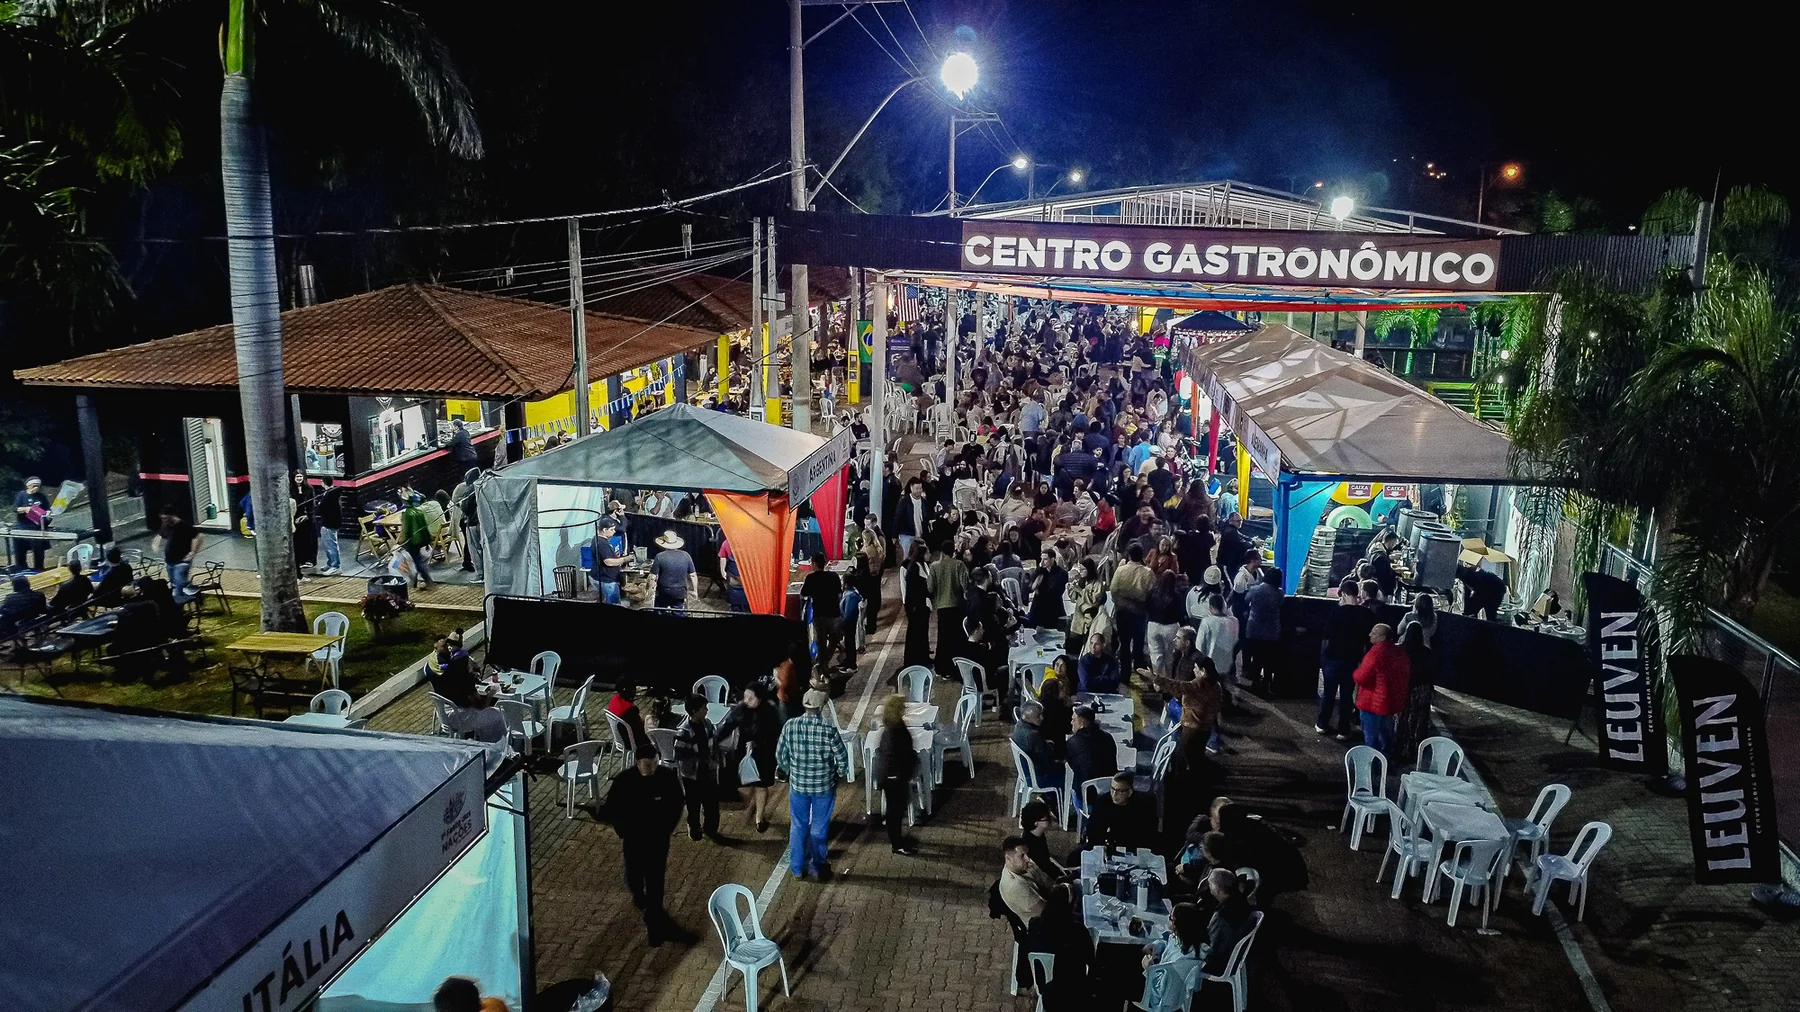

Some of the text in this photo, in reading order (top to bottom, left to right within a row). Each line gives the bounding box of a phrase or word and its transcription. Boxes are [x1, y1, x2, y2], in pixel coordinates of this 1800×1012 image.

[964, 235, 1495, 285] CENTRO GASTRONÔMICO
[809, 450, 837, 484] ARGENTINA
[1600, 612, 1645, 762] LEUVEN
[1692, 694, 1752, 871] LEUVEN
